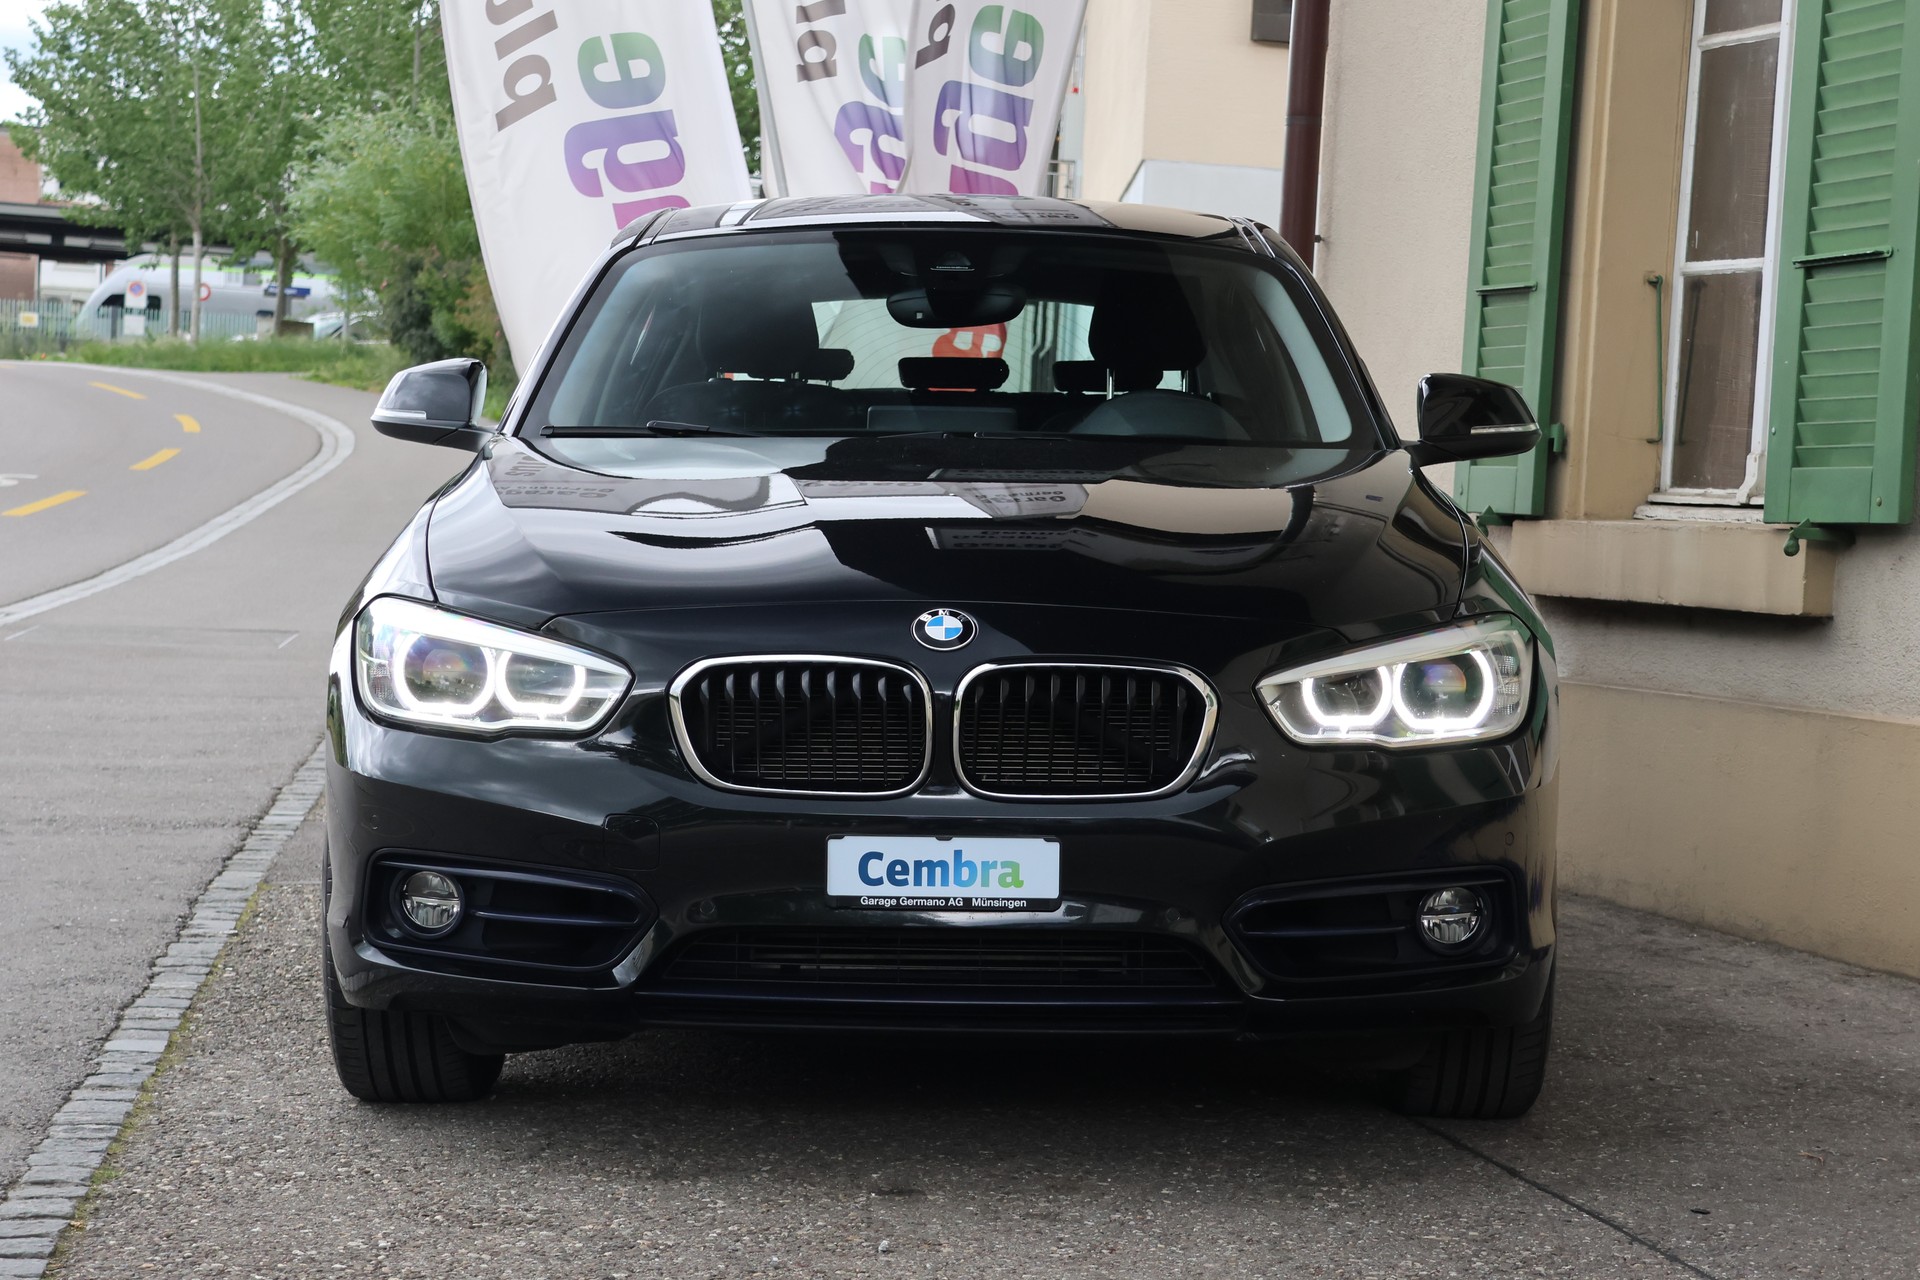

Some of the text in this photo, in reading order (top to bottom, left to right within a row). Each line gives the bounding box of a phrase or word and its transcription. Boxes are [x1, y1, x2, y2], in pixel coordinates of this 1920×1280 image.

[858, 849, 1024, 889] Cembra
[860, 896, 1027, 909] Garage Germano AG Münsingen
